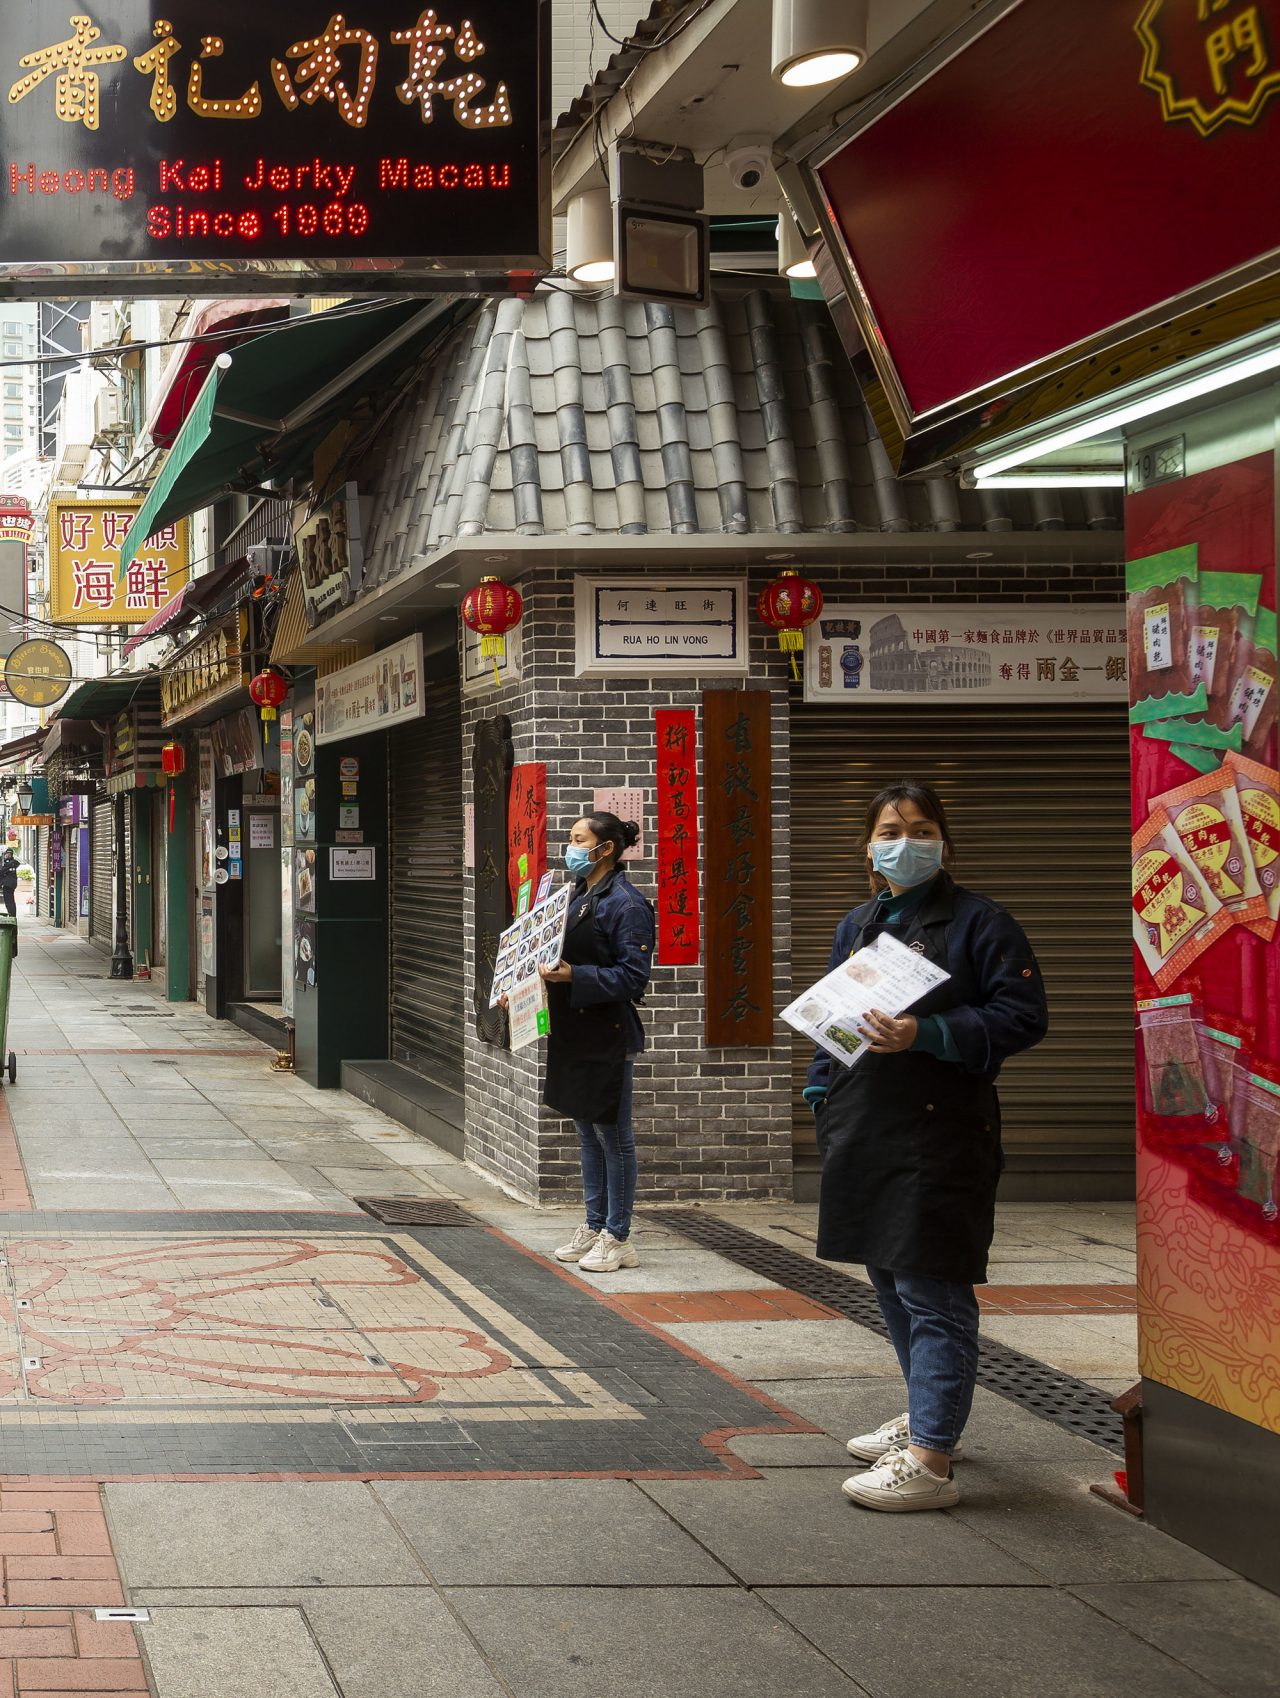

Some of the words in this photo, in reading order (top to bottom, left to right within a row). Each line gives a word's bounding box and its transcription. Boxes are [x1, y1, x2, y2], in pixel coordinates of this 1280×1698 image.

[1197, 0, 1268, 95] 門
[7, 8, 513, 131] 香記肉乾
[9, 161, 135, 199] Heong
[160, 158, 222, 192] Kei
[245, 157, 356, 197] Jerky
[380, 157, 511, 190] Macau
[146, 203, 261, 239] Since
[273, 202, 370, 237] 1969
[1135, 455, 1151, 483] 19
[72, 557, 169, 609] 海鮮
[618, 598, 715, 611] 何連旺街
[623, 636, 642, 645] RUA
[647, 636, 660, 645] HO
[665, 636, 679, 645] LIN
[683, 635, 708, 645] VONG
